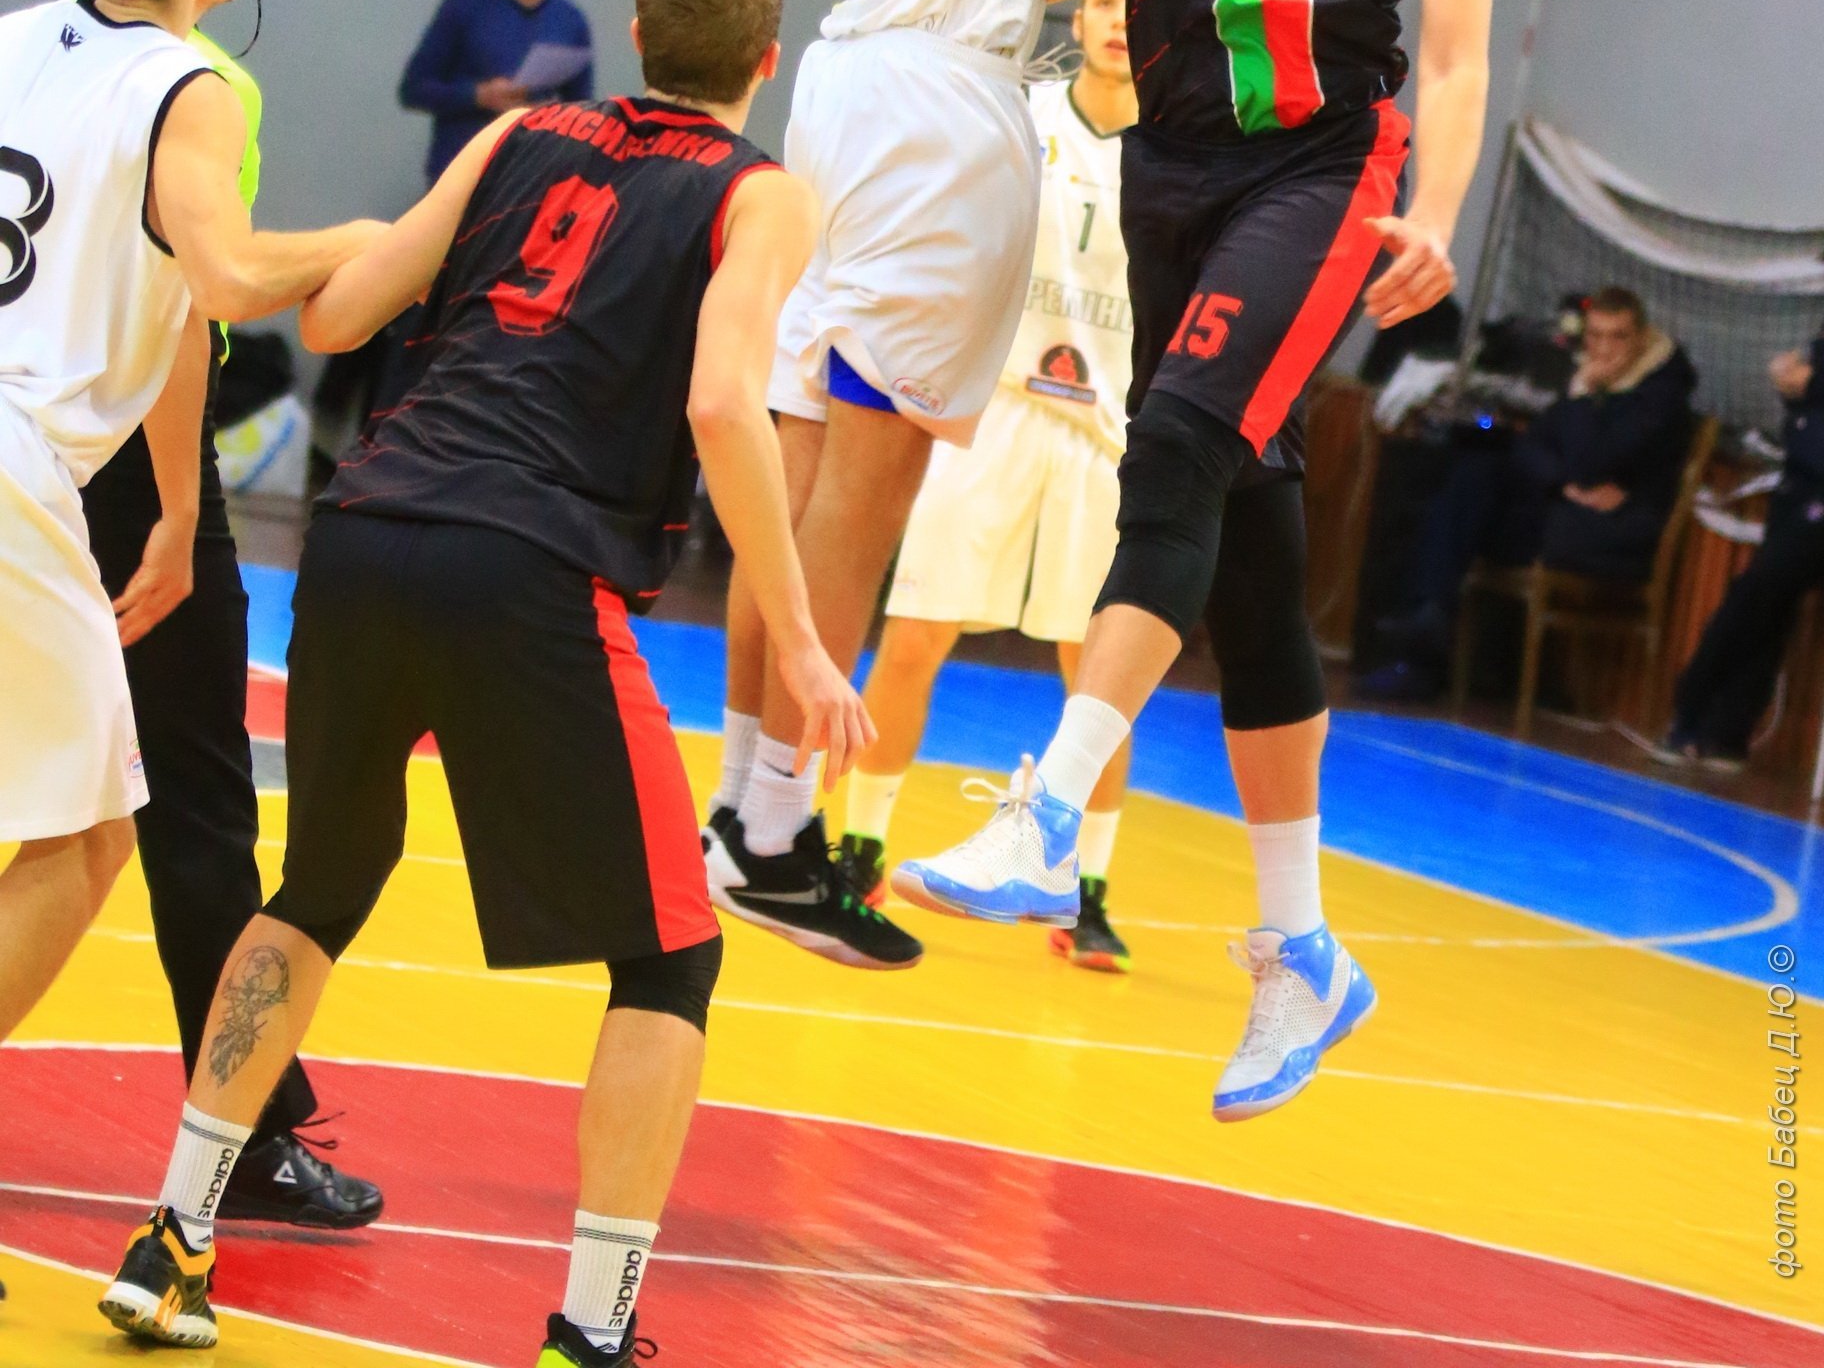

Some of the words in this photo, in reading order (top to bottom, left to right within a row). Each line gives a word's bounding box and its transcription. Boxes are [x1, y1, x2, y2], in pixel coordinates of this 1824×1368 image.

[487, 174, 620, 336] 9
[1078, 202, 1096, 254] 1
[1166, 292, 1244, 361] 15
[197, 1147, 235, 1219] adidas
[608, 1249, 642, 1328] adidas
